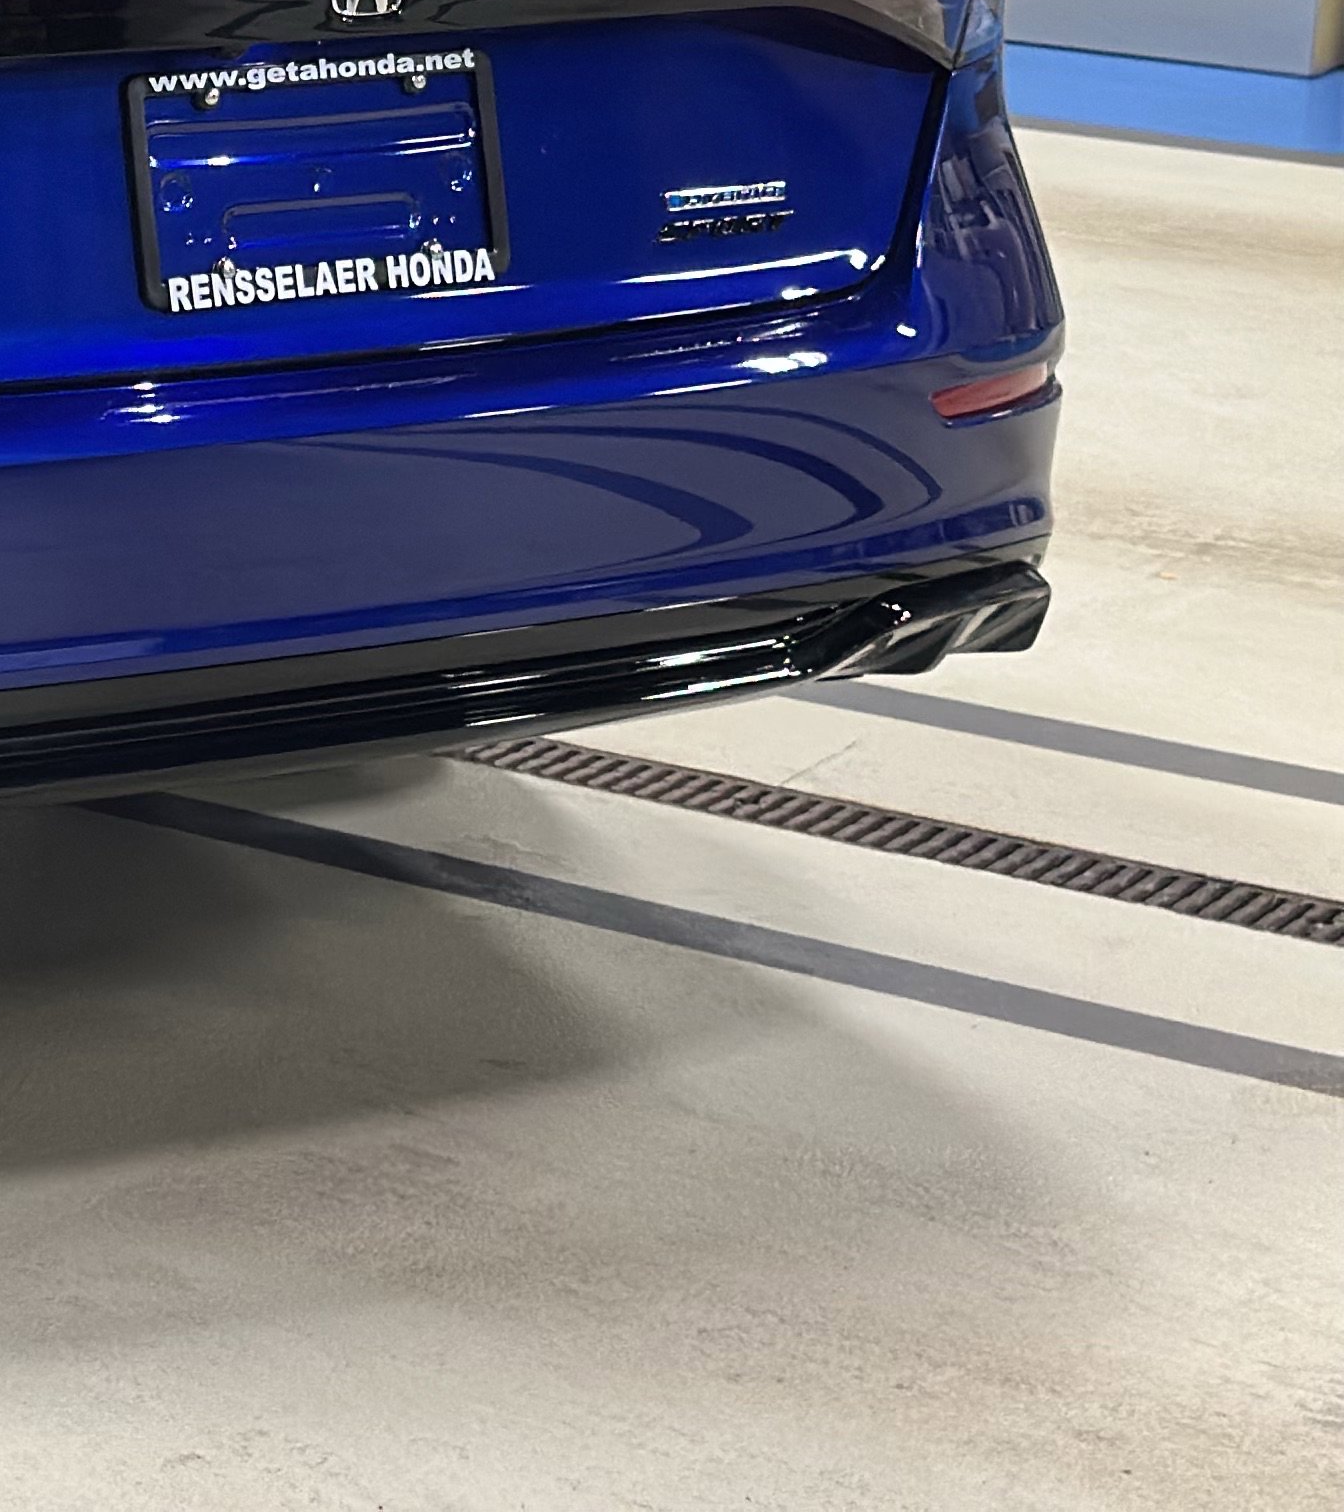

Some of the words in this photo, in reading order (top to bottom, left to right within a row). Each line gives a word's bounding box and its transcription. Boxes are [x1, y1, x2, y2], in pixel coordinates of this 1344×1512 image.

[148, 47, 476, 93] www.getahonda.net
[168, 256, 380, 313] RENSSELAER
[387, 249, 496, 290] HONDA
